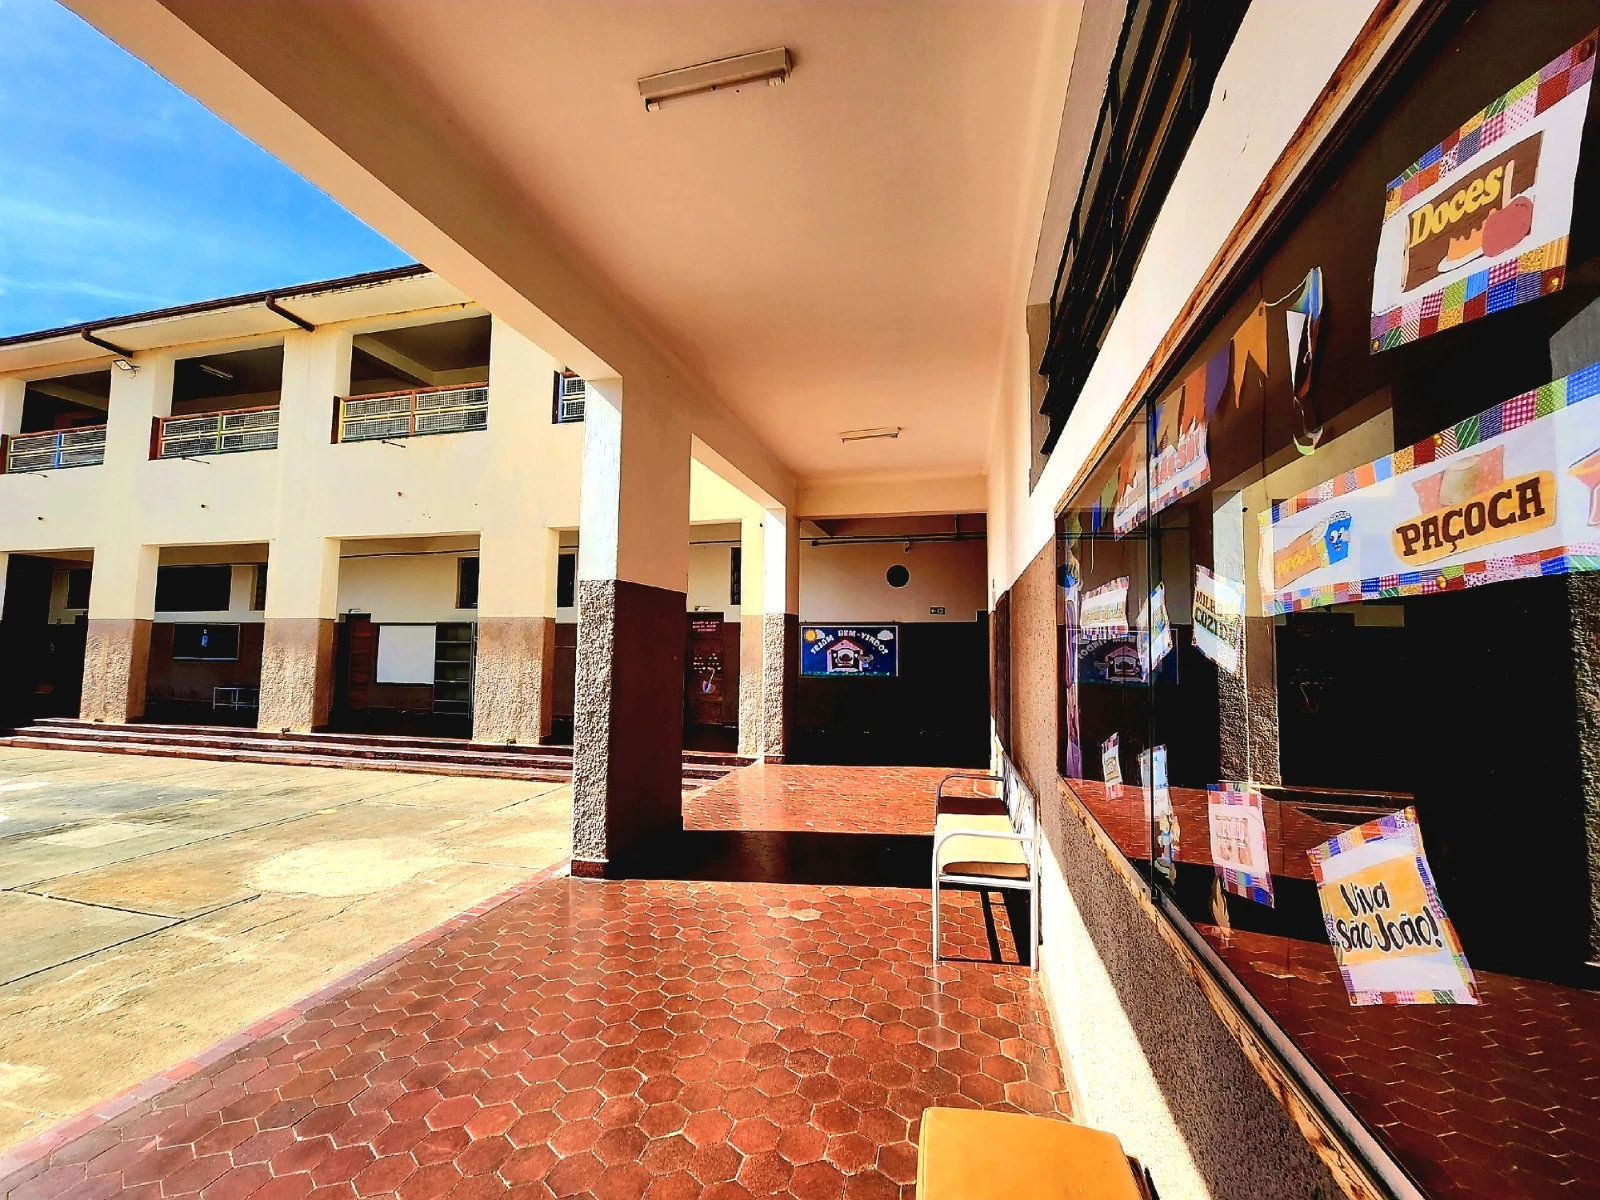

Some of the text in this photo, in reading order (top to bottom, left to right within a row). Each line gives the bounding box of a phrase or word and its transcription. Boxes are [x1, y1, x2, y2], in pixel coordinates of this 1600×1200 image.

[1409, 166, 1503, 248] Doces
[1396, 477, 1545, 556] PAÇOCA
[1340, 882, 1390, 917] Viva
[1374, 913, 1442, 951] João!
